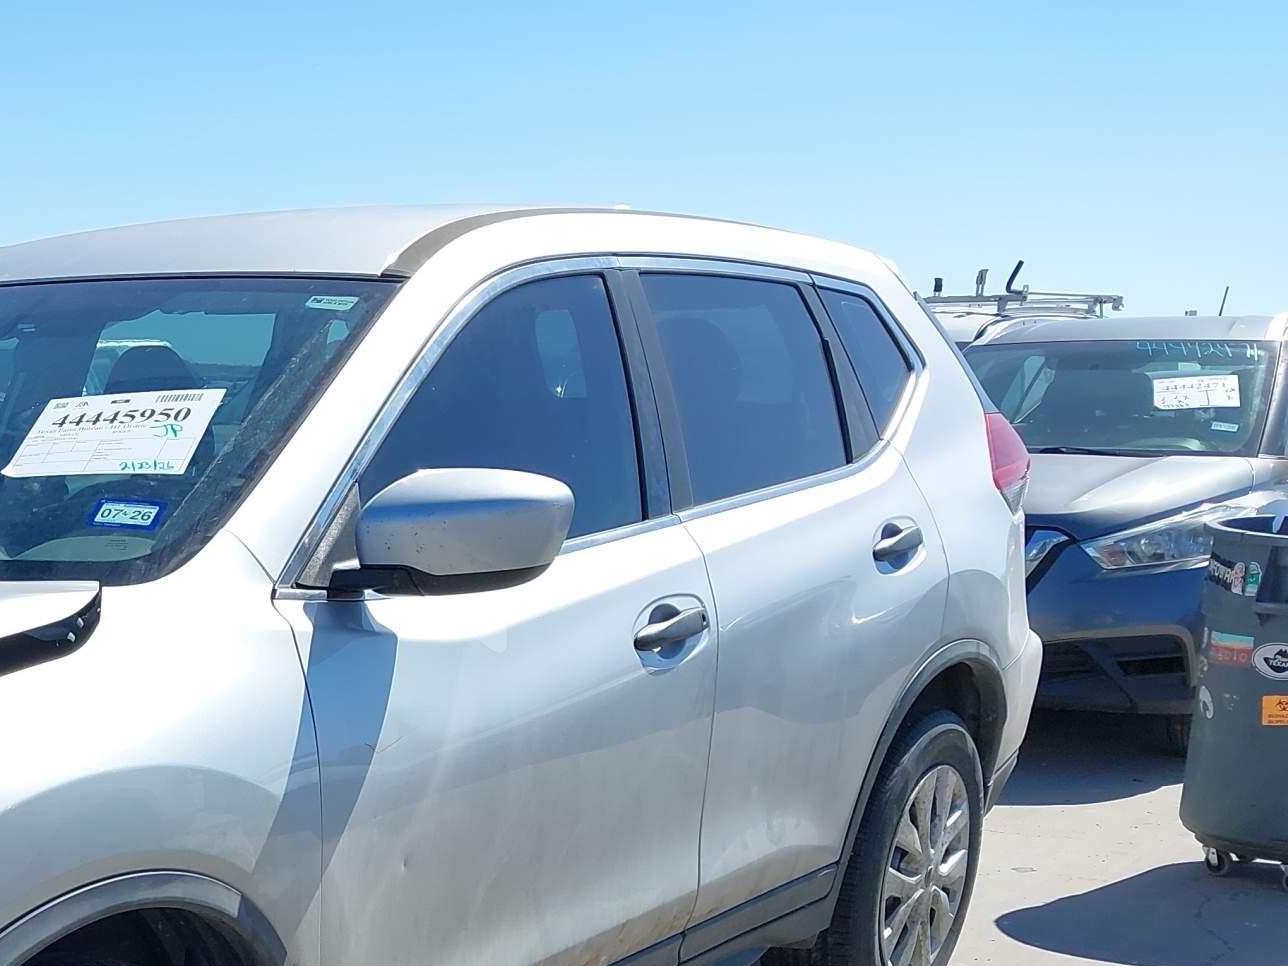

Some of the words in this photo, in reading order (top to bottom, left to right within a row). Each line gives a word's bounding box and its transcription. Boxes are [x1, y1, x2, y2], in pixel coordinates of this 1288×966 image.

[52, 407, 191, 428] 44445950
[100, 508, 123, 519] 07
[129, 510, 152, 521] 26
[1269, 659, 1288, 668] TEXA
